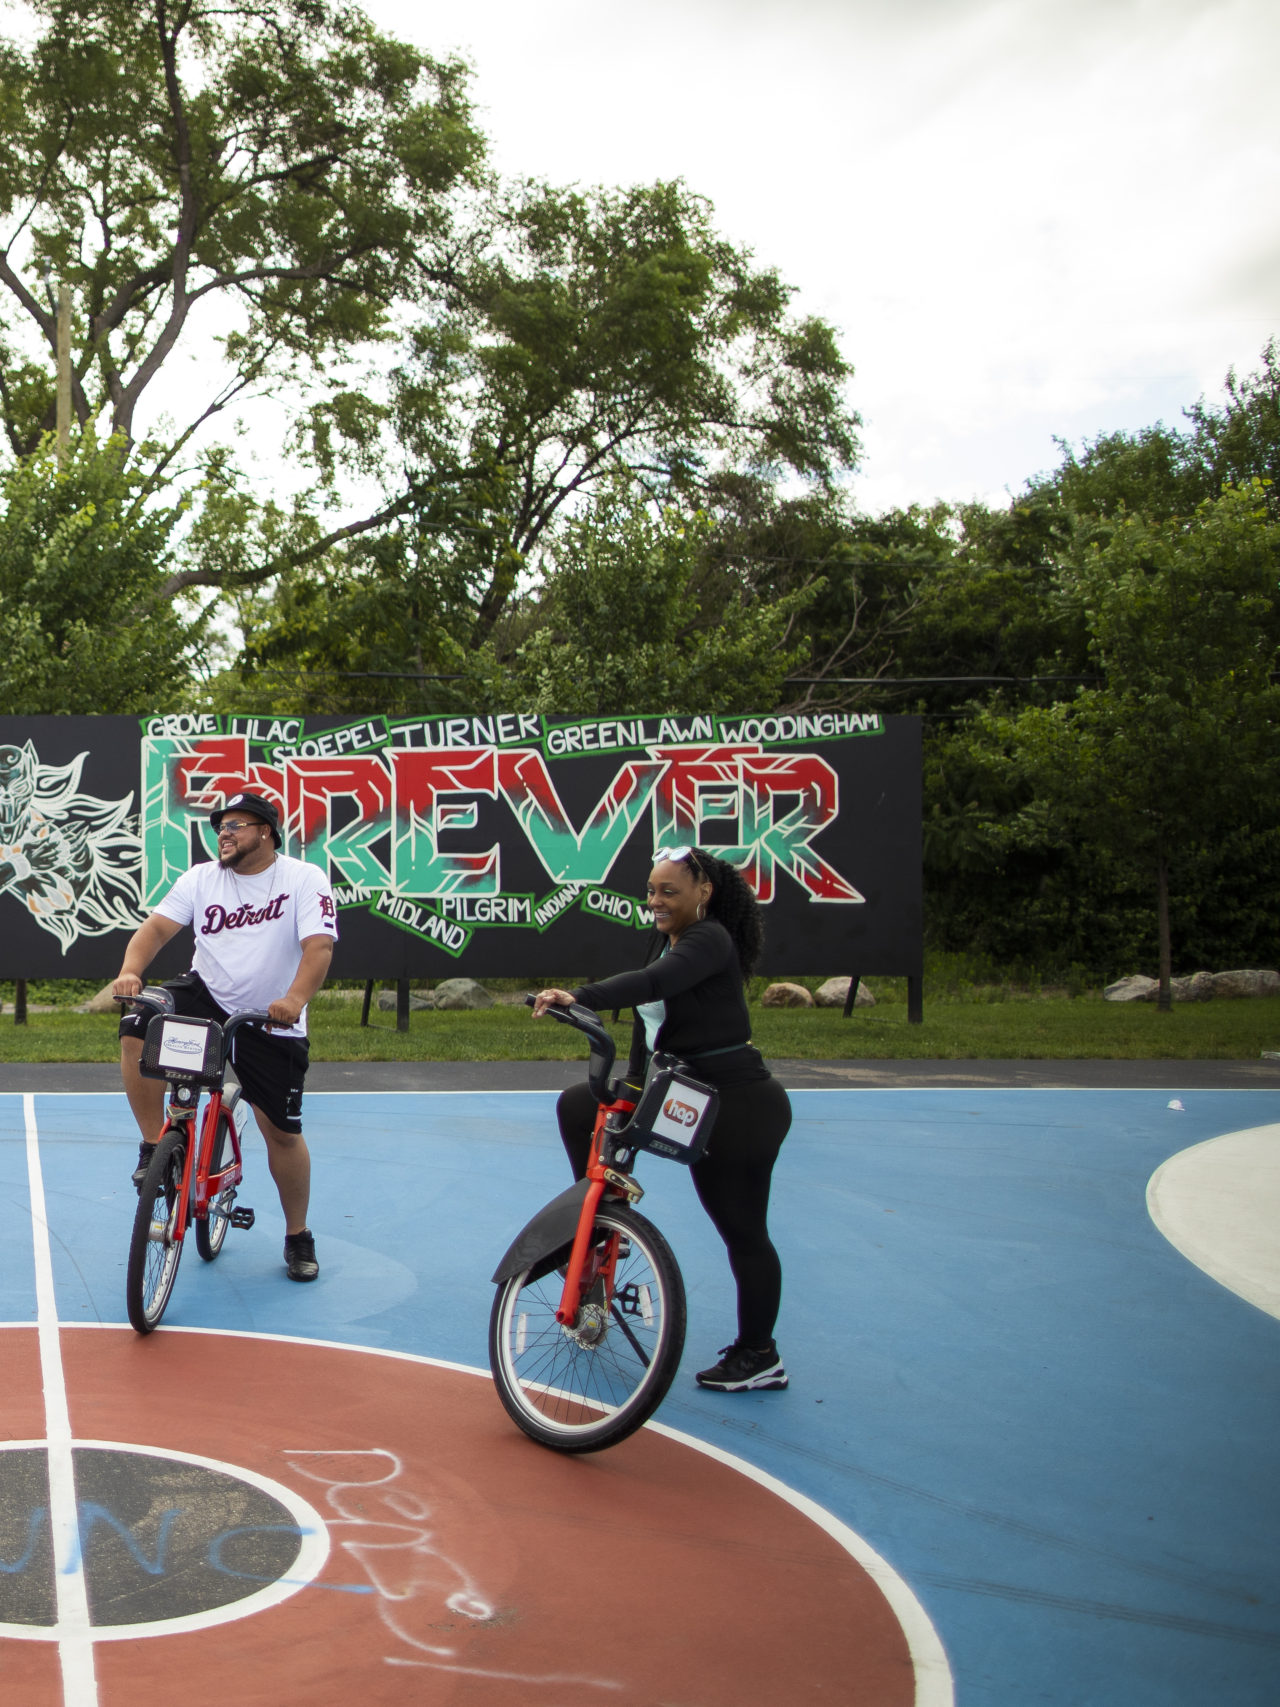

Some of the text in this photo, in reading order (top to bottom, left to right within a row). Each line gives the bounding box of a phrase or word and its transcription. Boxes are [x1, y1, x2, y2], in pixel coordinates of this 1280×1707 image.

[147, 714, 217, 737] GROVE
[231, 718, 300, 744] LILAC
[390, 713, 540, 750] TURNER
[546, 714, 714, 755] GREENLAWN
[719, 714, 880, 744] WOODINGHAM
[200, 892, 290, 936] Detroit
[441, 896, 532, 923] PILGRIM
[586, 890, 633, 920] OHIO
[375, 890, 466, 951] MIDLAND
[666, 1100, 696, 1127] hap
